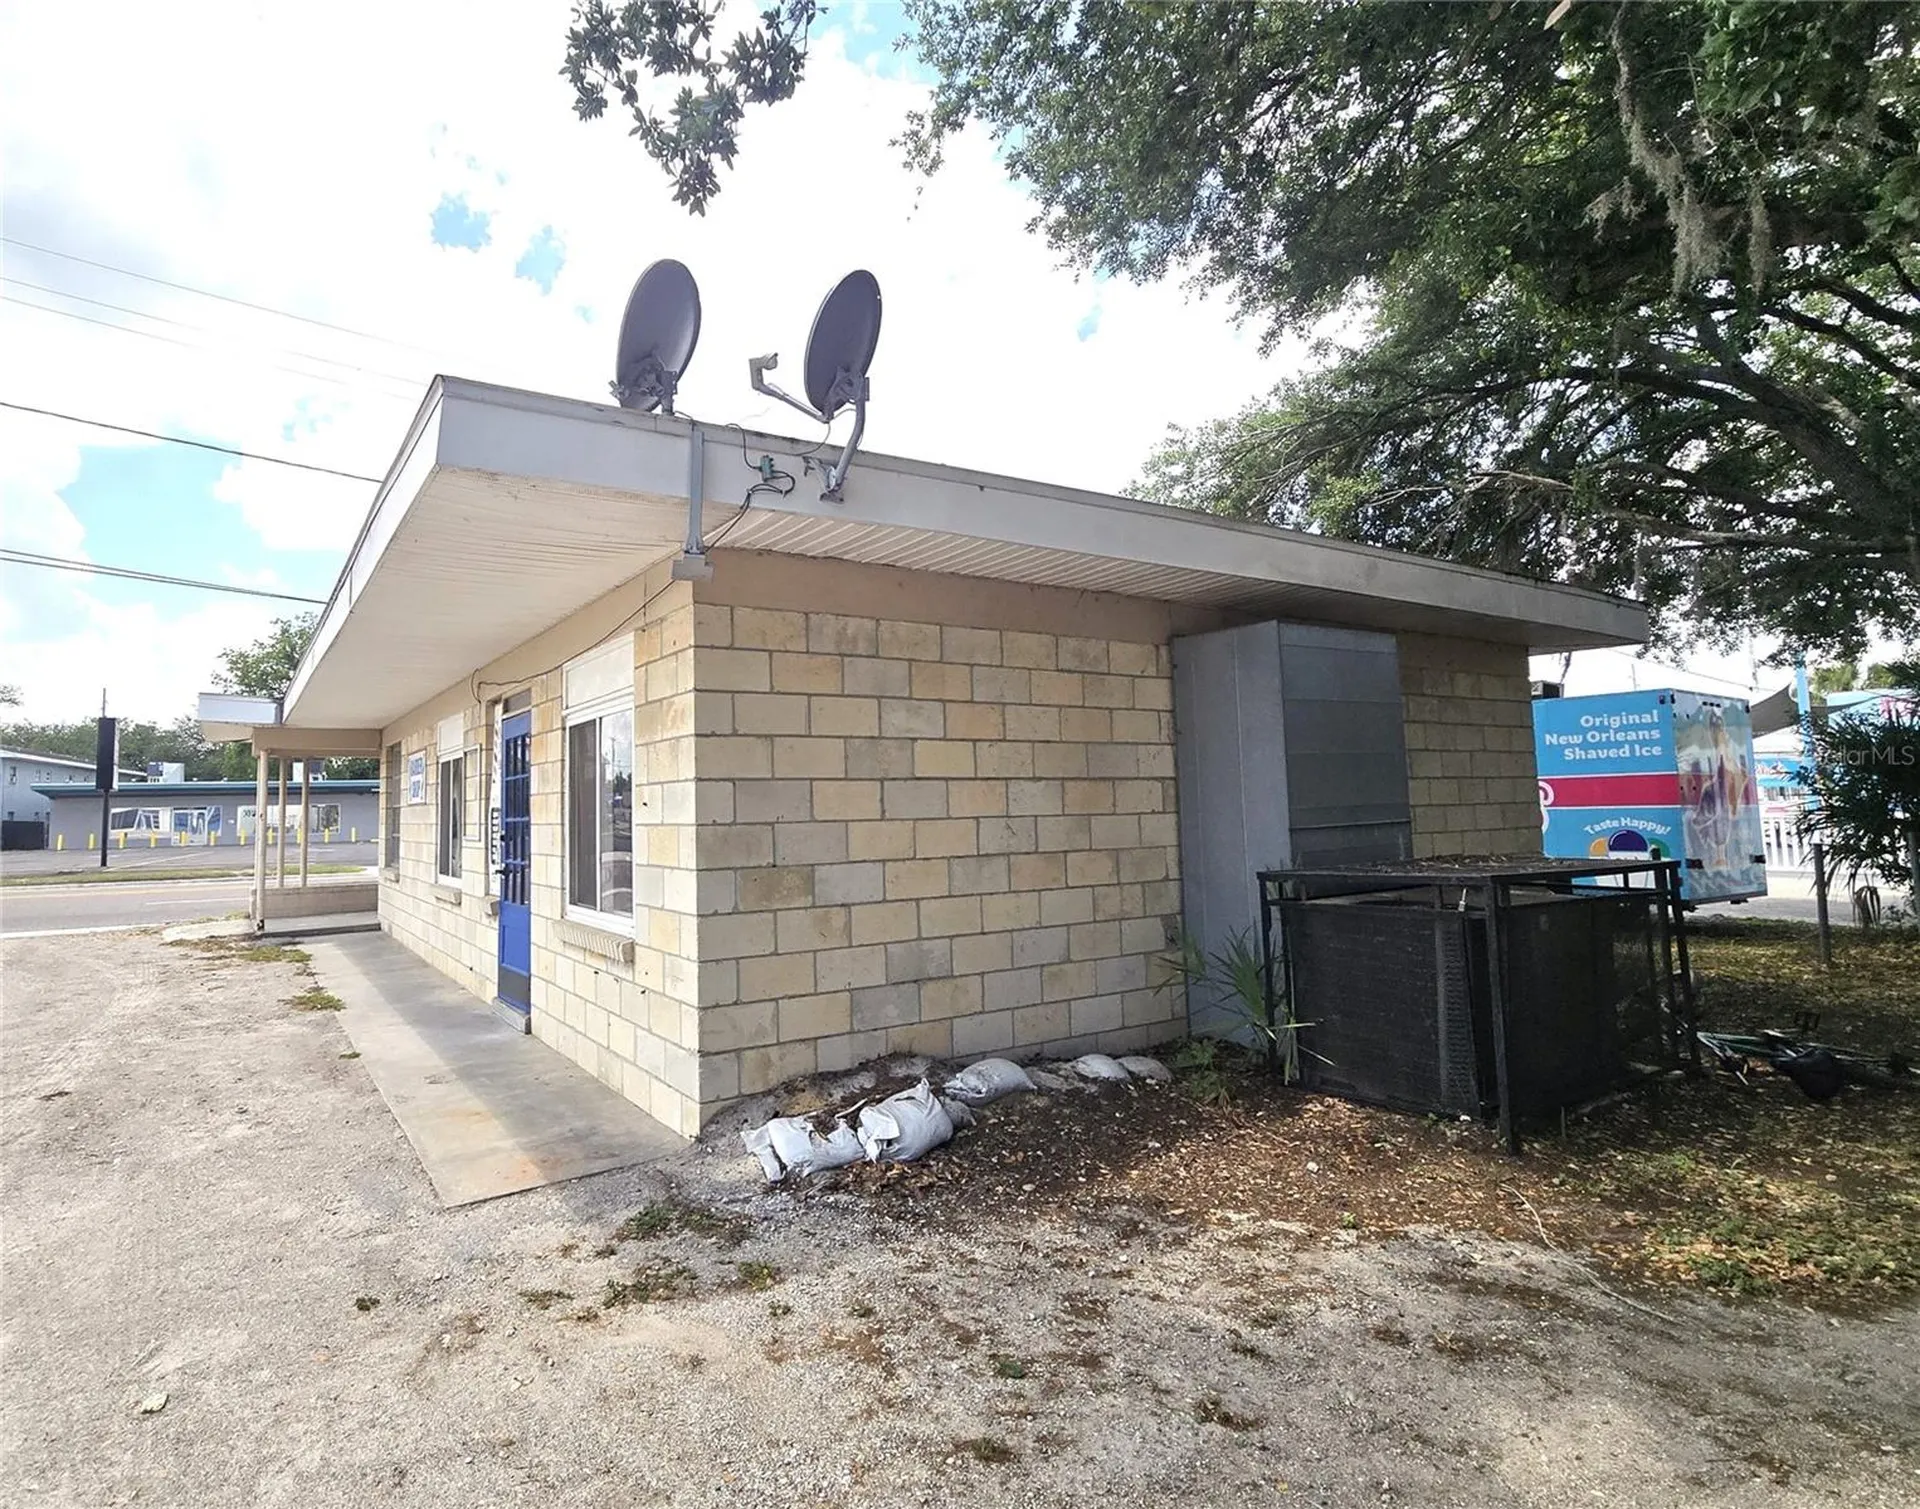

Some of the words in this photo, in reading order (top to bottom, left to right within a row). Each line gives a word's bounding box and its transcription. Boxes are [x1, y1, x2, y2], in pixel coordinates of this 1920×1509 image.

[1580, 709, 1659, 728] Original
[1544, 733, 1582, 745] New
[1586, 729, 1660, 743] Orleans
[1563, 744, 1630, 760] Shaved
[1634, 744, 1662, 757] Ice
[1584, 819, 1619, 835] Taste
[1620, 817, 1671, 835] Happy!
